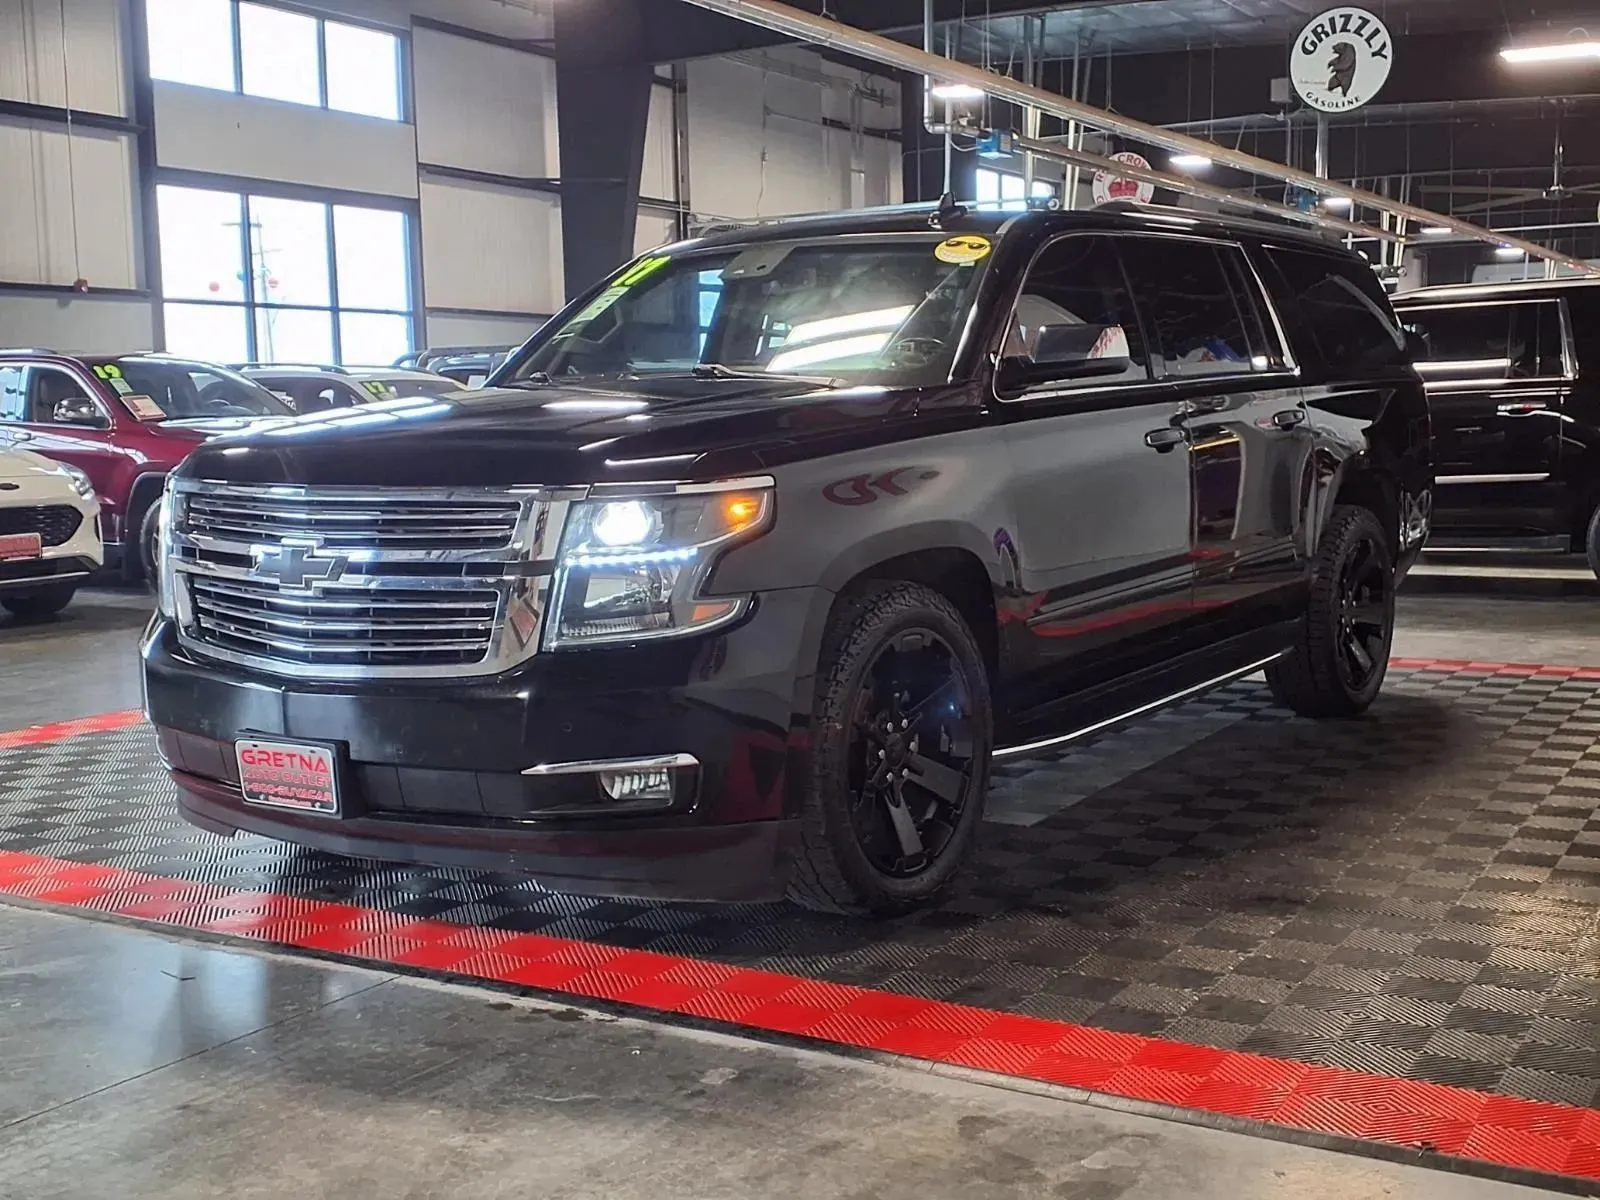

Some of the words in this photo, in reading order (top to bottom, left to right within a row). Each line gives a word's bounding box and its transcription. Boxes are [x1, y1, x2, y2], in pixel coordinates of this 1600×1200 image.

[1301, 13, 1388, 60] GRIZZLY
[1305, 91, 1361, 109] GASOLINE
[92, 364, 122, 380] 19
[241, 748, 330, 775] GRETNA
